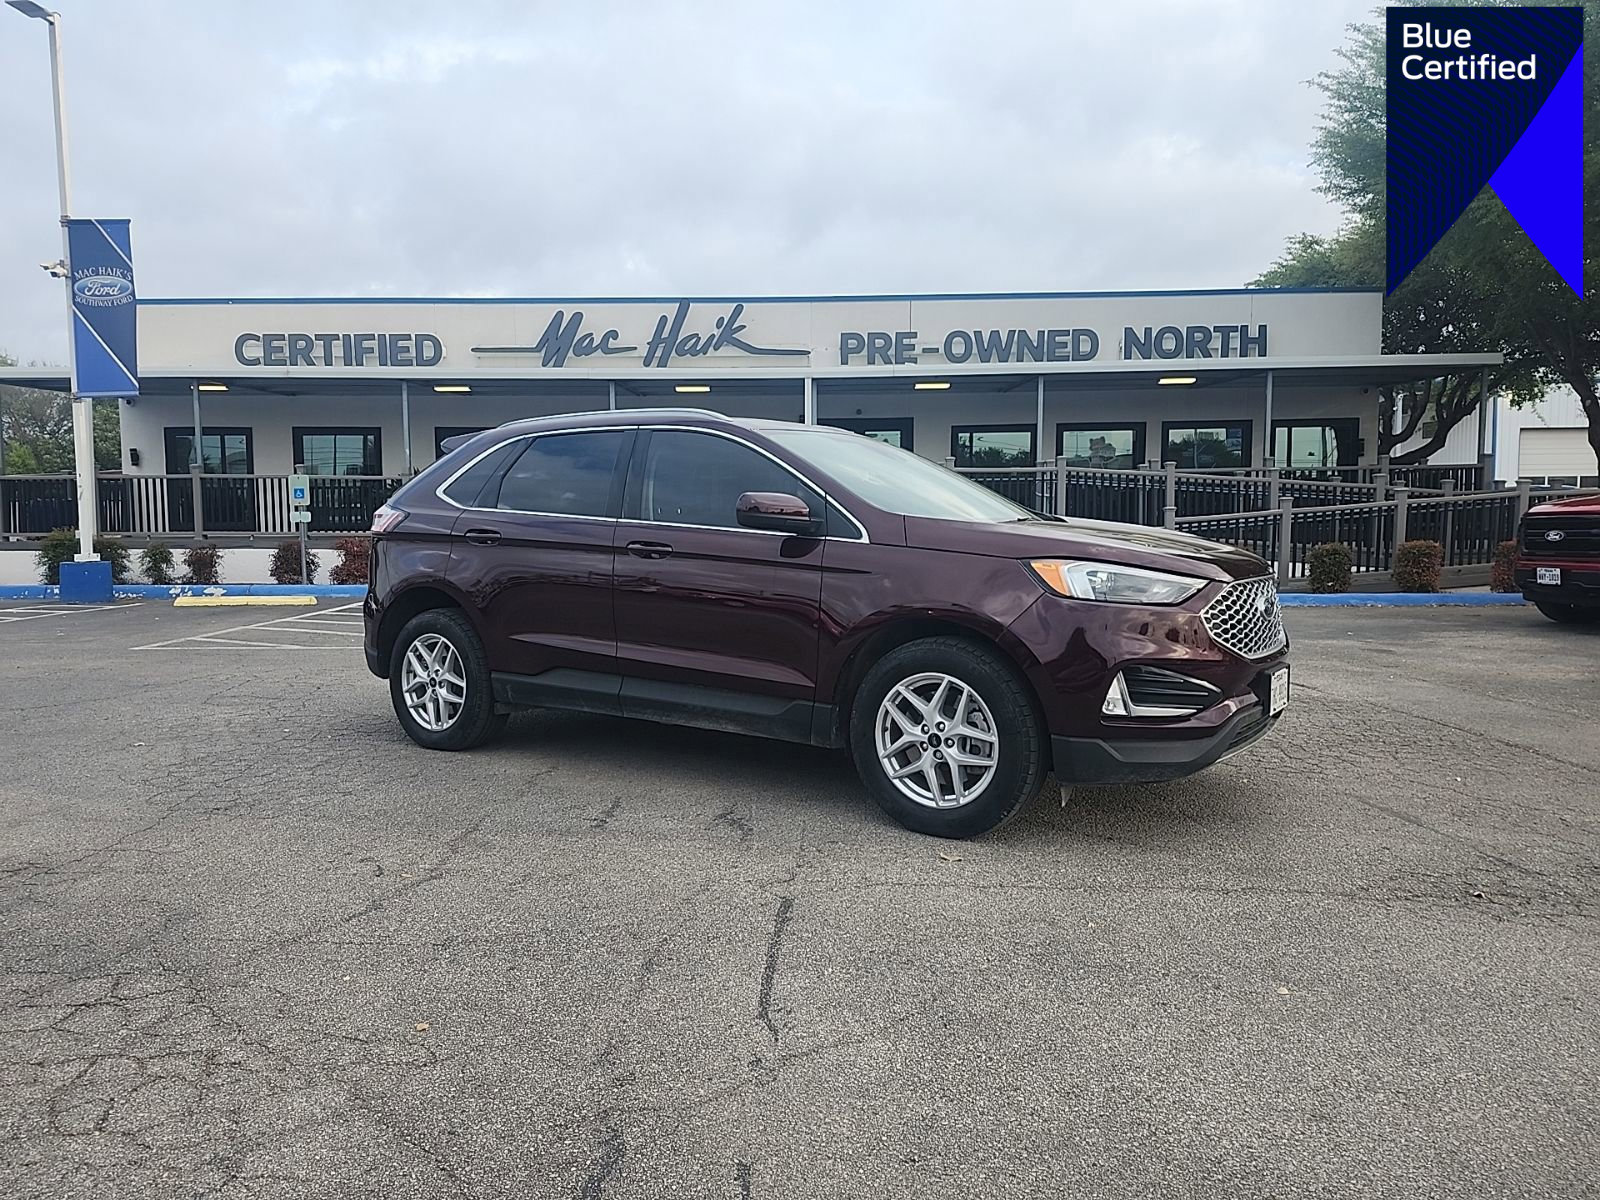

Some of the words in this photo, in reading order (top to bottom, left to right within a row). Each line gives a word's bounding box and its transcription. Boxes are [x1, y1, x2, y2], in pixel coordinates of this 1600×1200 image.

[74, 267, 95, 280] MAC
[99, 266, 132, 281] HAIK'S
[85, 279, 120, 295] Ford
[75, 295, 112, 307] SOUTHWAY
[113, 295, 133, 306] FORD
[471, 310, 637, 368] Mac
[643, 300, 811, 367] Haik
[840, 328, 1100, 366] PRE-OWNED
[1123, 324, 1268, 360] NORTH
[235, 333, 444, 367] CERTIFIED
